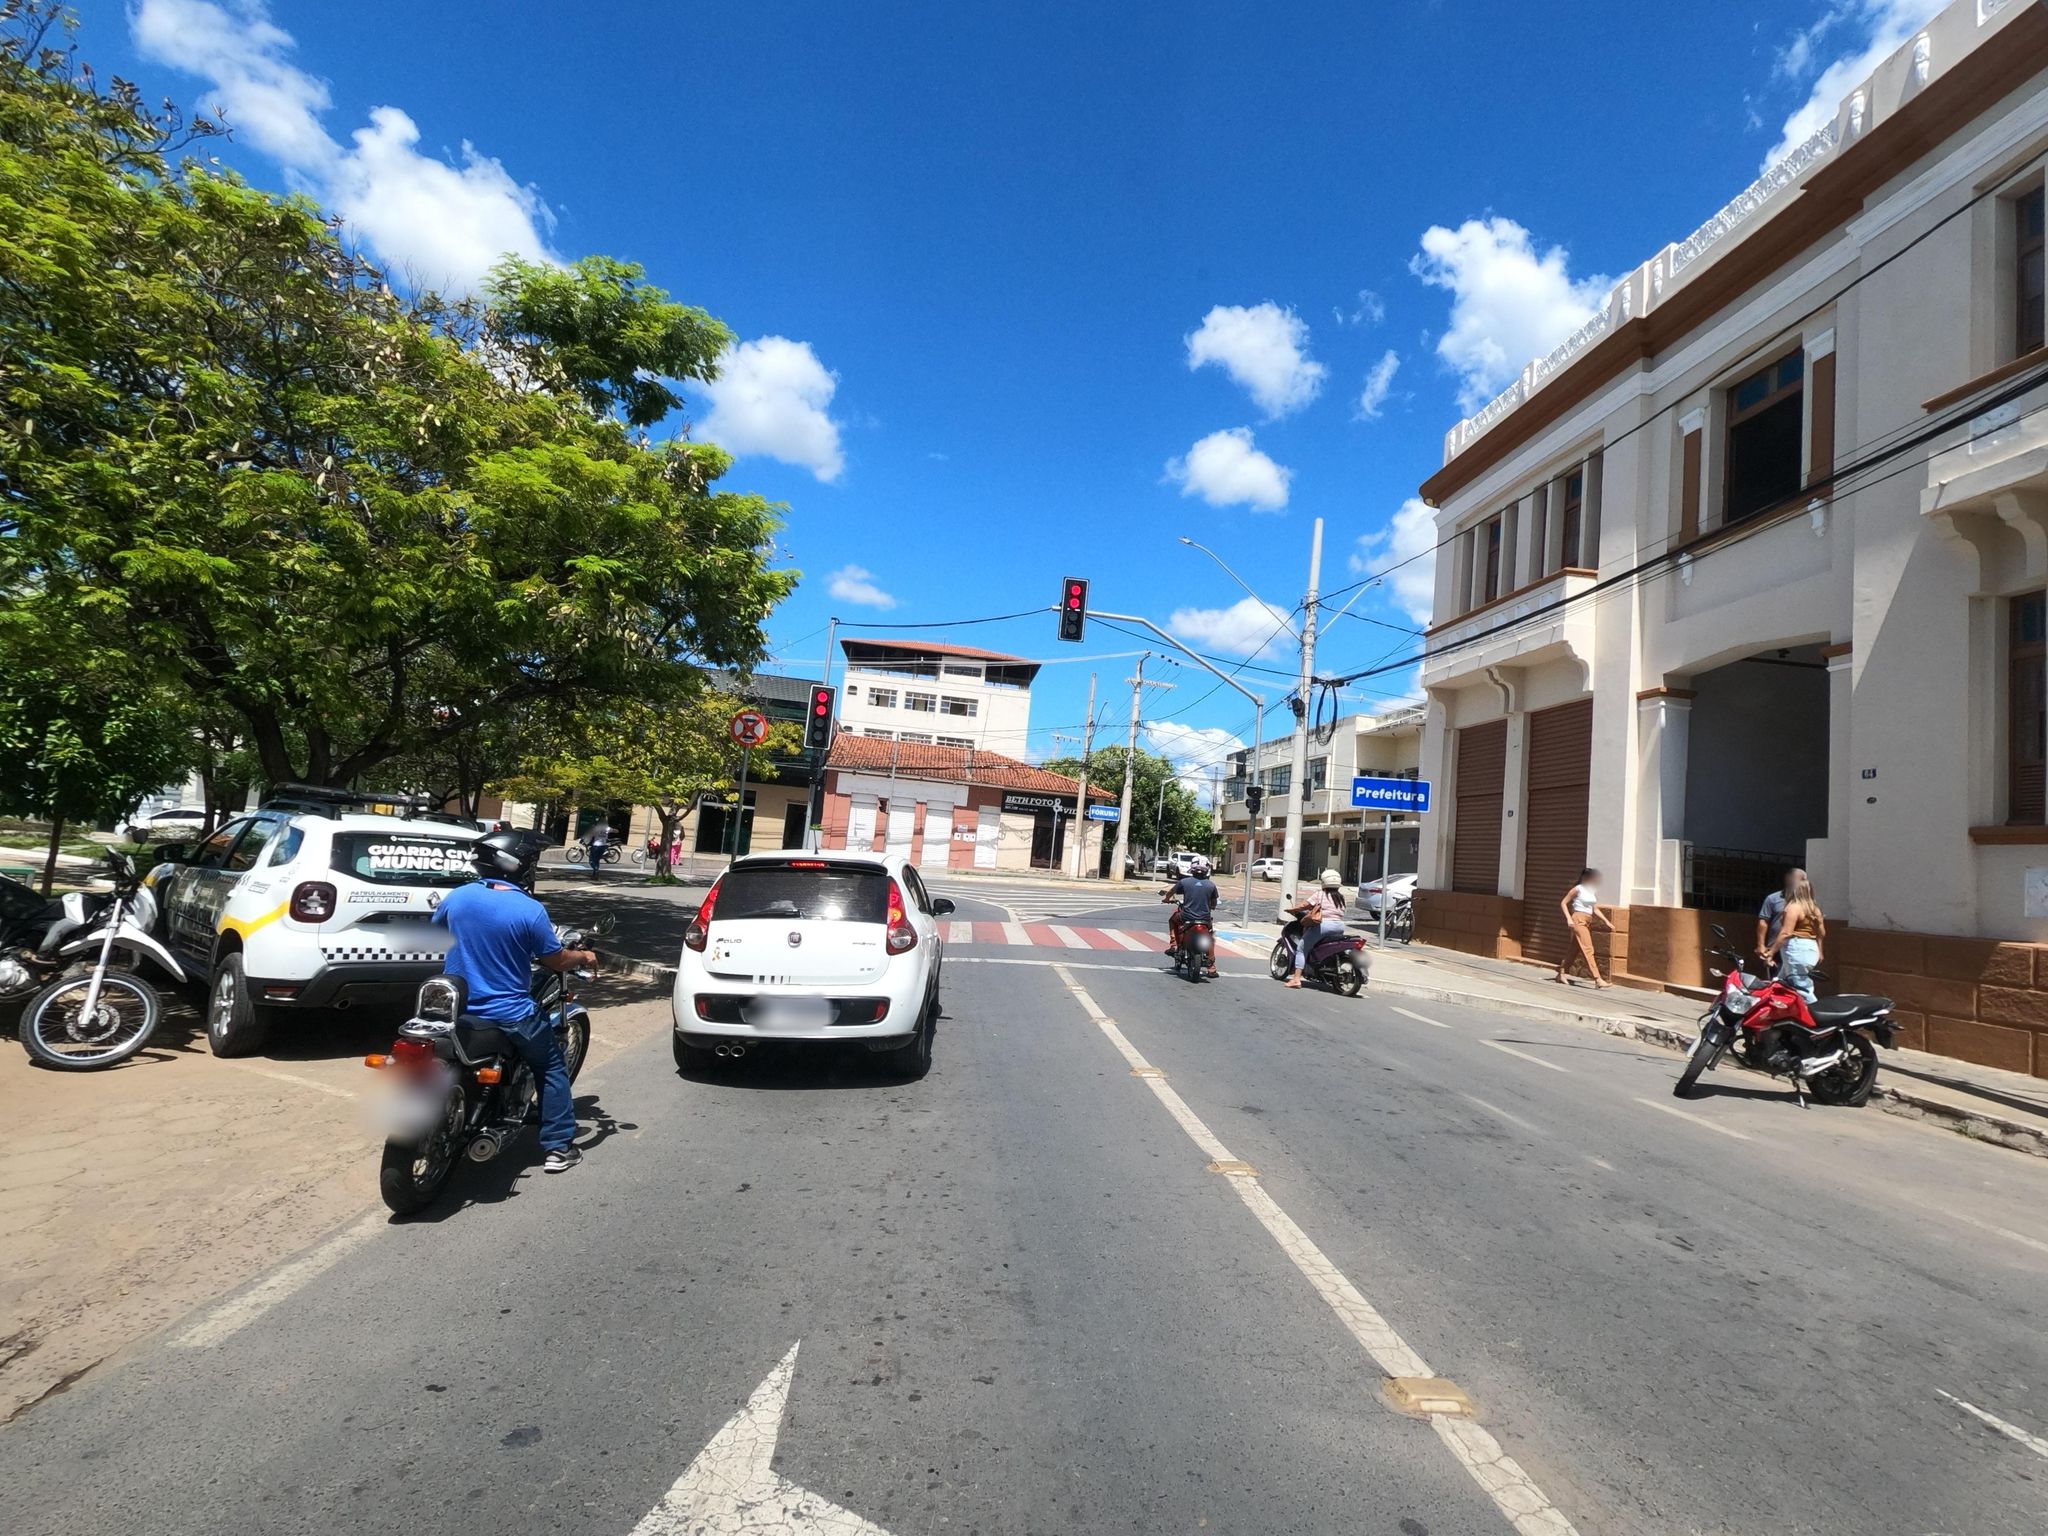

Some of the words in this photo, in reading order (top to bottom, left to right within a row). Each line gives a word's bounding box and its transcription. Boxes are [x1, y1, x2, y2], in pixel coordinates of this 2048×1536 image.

[1005, 796, 1028, 804] BETH
[1030, 798, 1054, 806] FOTO
[1356, 787, 1425, 802] Prefeitura
[368, 845, 444, 858] GUARDA
[445, 849, 475, 860] CIV
[369, 856, 478, 873] MUNICIPA
